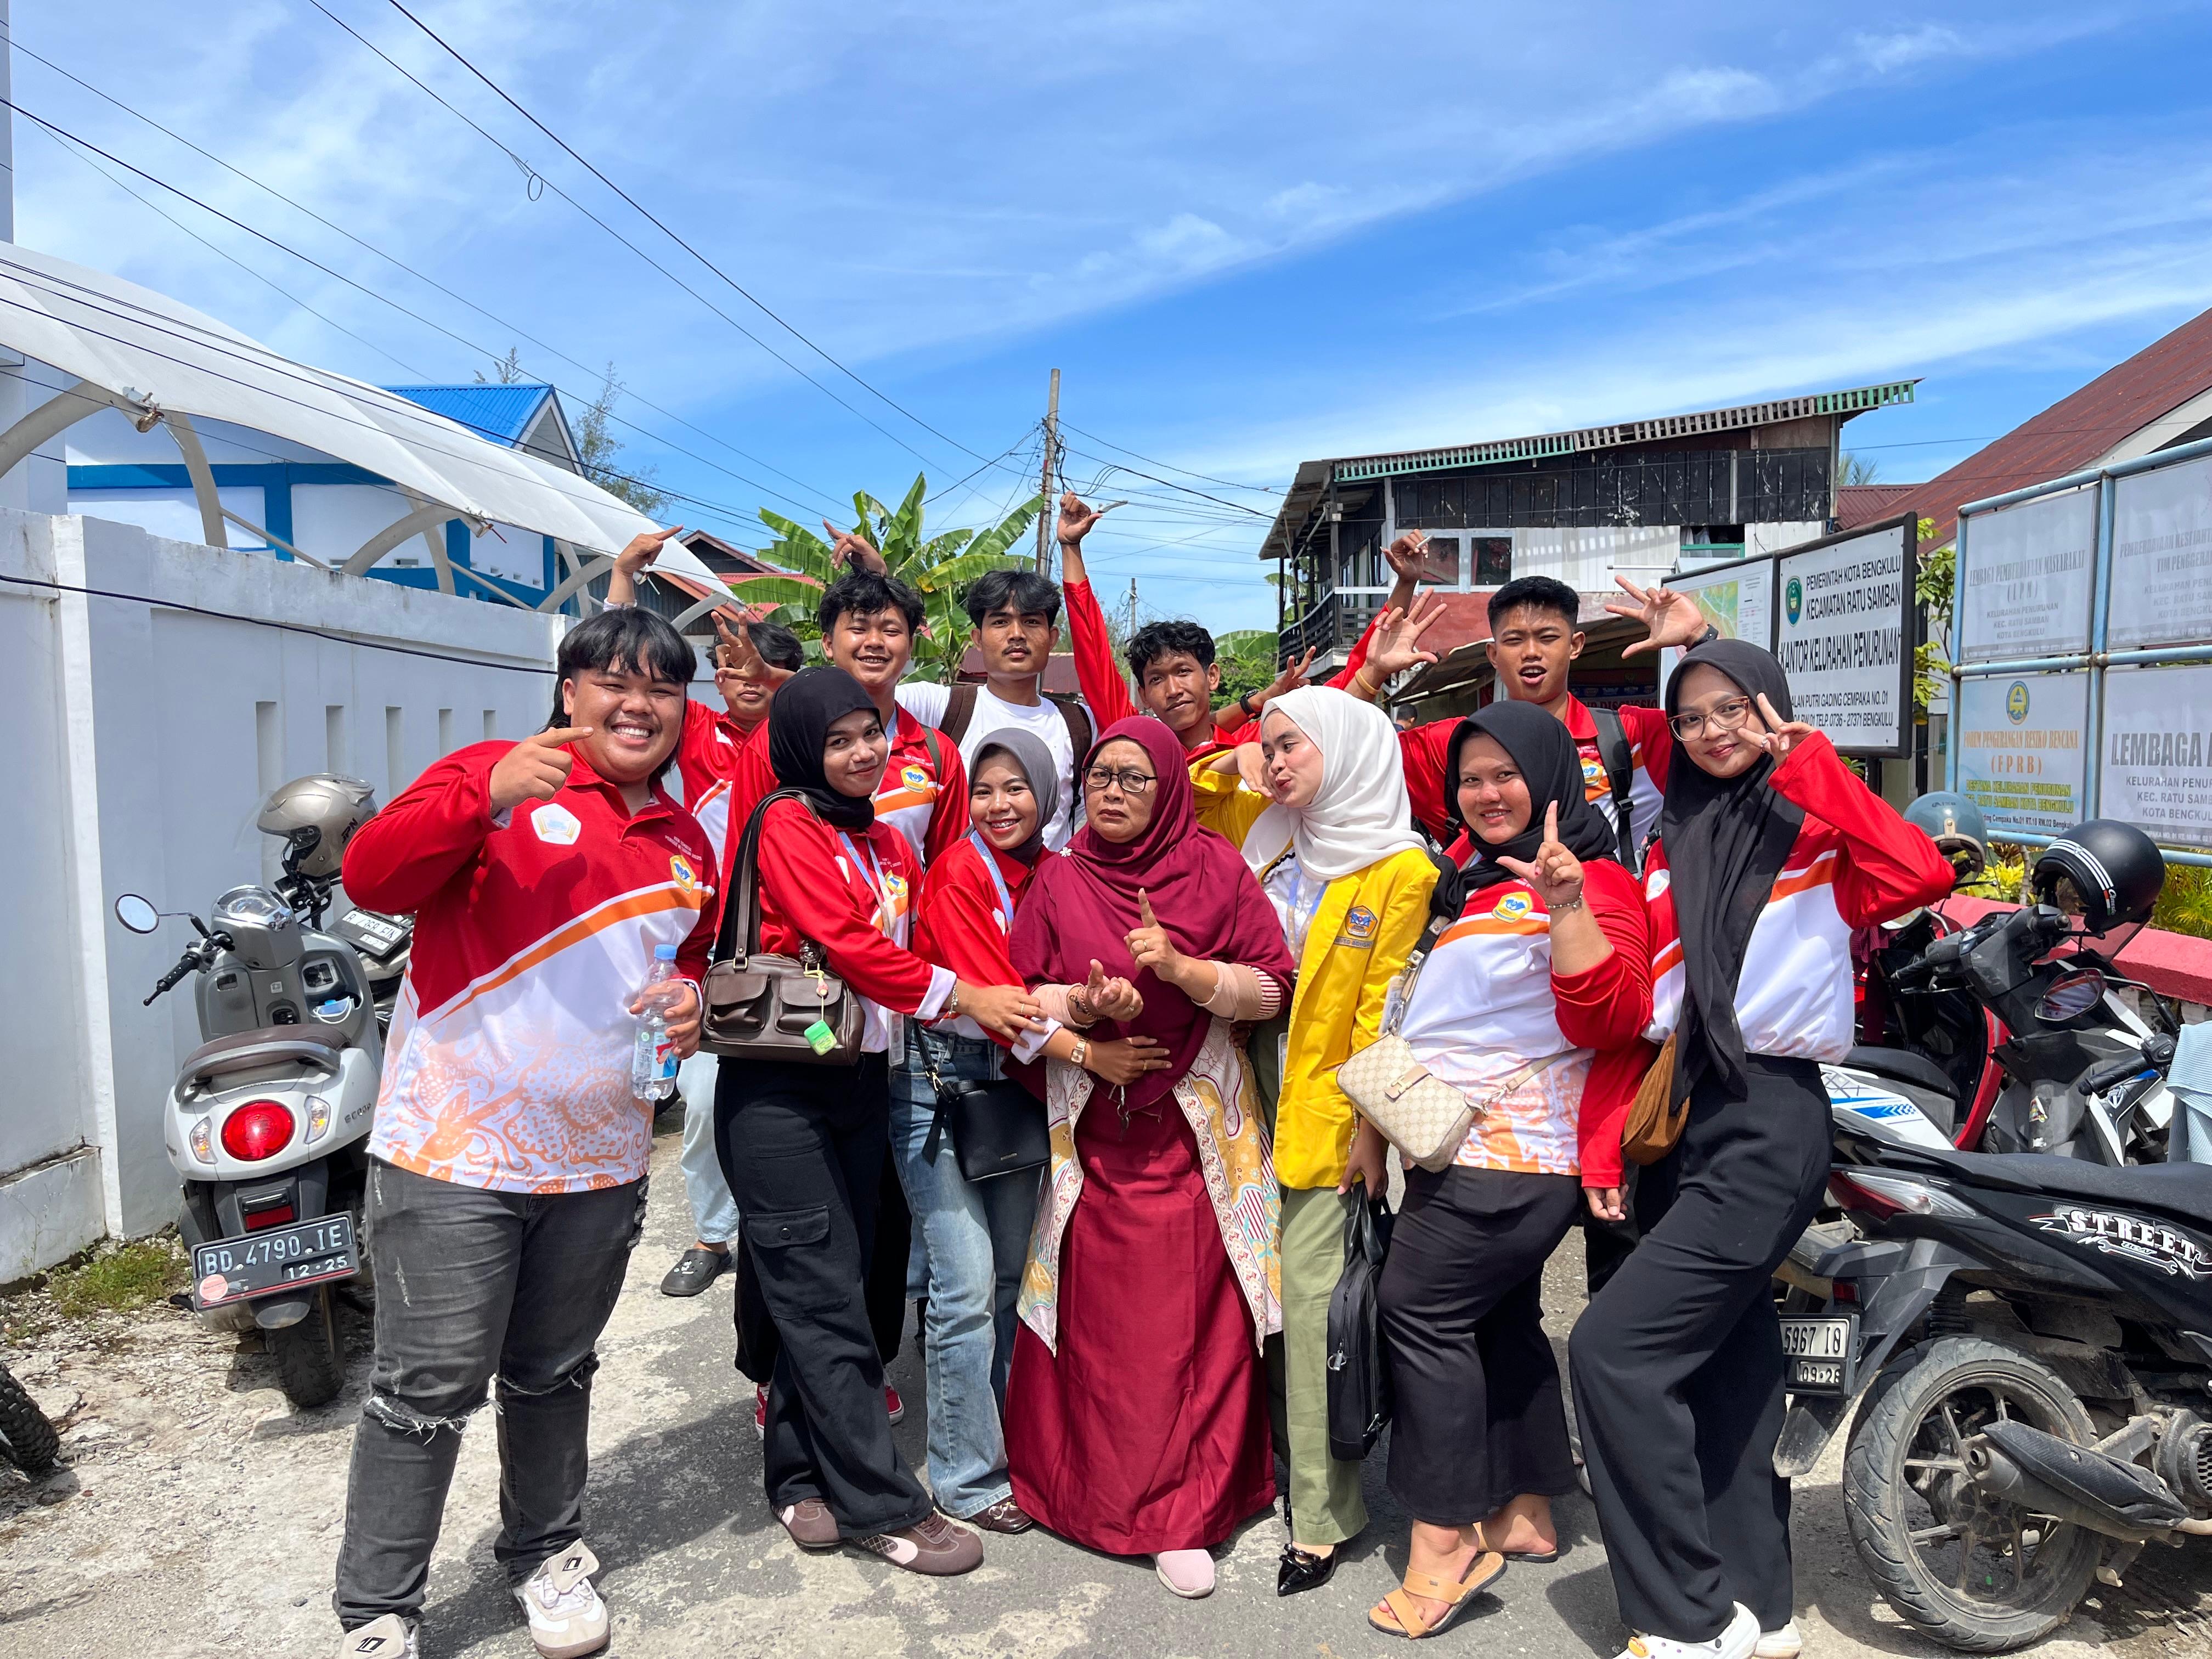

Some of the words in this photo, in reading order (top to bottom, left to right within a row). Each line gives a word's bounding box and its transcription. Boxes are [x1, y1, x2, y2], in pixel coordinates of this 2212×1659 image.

[1807, 568, 1842, 591] PEMERINTAH
[1844, 564, 1860, 583] KOTA
[1863, 555, 1900, 578] BENGKULU
[1970, 567, 1994, 586] LEMBAGA
[2045, 550, 2085, 574] MASYARAKAT
[2157, 557, 2170, 573] TIM
[2144, 579, 2190, 594] KELURAHAN
[1807, 592, 1846, 620] KECAMATAN
[1847, 588, 1865, 613] RATU
[1867, 582, 1900, 610] SAMBAN
[2174, 592, 2194, 603] RATU
[1987, 608, 2021, 618] KELURAHAN
[2022, 602, 2058, 614] PENURUNAN
[2158, 610, 2178, 619] KOTA
[2008, 619, 2023, 627] RATU
[2024, 616, 2049, 625] SAMBAN
[1997, 631, 2011, 640] KOTA
[2013, 628, 2045, 638] BENGKULU
[1781, 640, 1808, 674] KANTOR
[1810, 634, 1852, 672] KELURAHAN
[1854, 627, 1900, 668] PENURUNAN
[1791, 694, 1804, 708] ALAN
[1805, 693, 1820, 707] PUTRI
[1821, 693, 1842, 707] GADING
[1843, 691, 1870, 706] CEMPAKA
[1871, 691, 1881, 705] NO.
[1882, 690, 1888, 704] 01
[1816, 714, 1829, 727] TELP.
[1830, 713, 1843, 726] 0736
[1847, 713, 1861, 726] 27371
[1863, 712, 1893, 726] BENGKULU
[1964, 731, 1981, 748] FORUM
[1983, 730, 2024, 748] PENGURANGAN
[2024, 730, 2047, 748] RESIKO
[2049, 730, 2078, 749] BENCANA
[2111, 732, 2202, 767] LEMBAGA
[1993, 781, 2029, 794] KELURAHAN
[2030, 782, 2071, 797] PENURUNAN
[2126, 776, 2179, 787] KELURAHAN
[1978, 794, 1993, 807] RATU
[1994, 795, 2019, 809] SAMBAN
[2020, 797, 2036, 810] KOTA
[2038, 798, 2074, 813] BENGKULU
[2137, 791, 2157, 802] KEC.
[2161, 793, 2184, 803] RATU
[1993, 815, 2011, 823] Cempaka
[2142, 808, 2165, 818] KOTA
[341, 817, 358, 844] JPN
[2069, 1210, 2197, 1261] STREET
[204, 1250, 233, 1275] BD
[246, 1235, 301, 1265] 4790
[317, 1224, 343, 1251] IE
[1784, 1327, 1816, 1355] 5967
